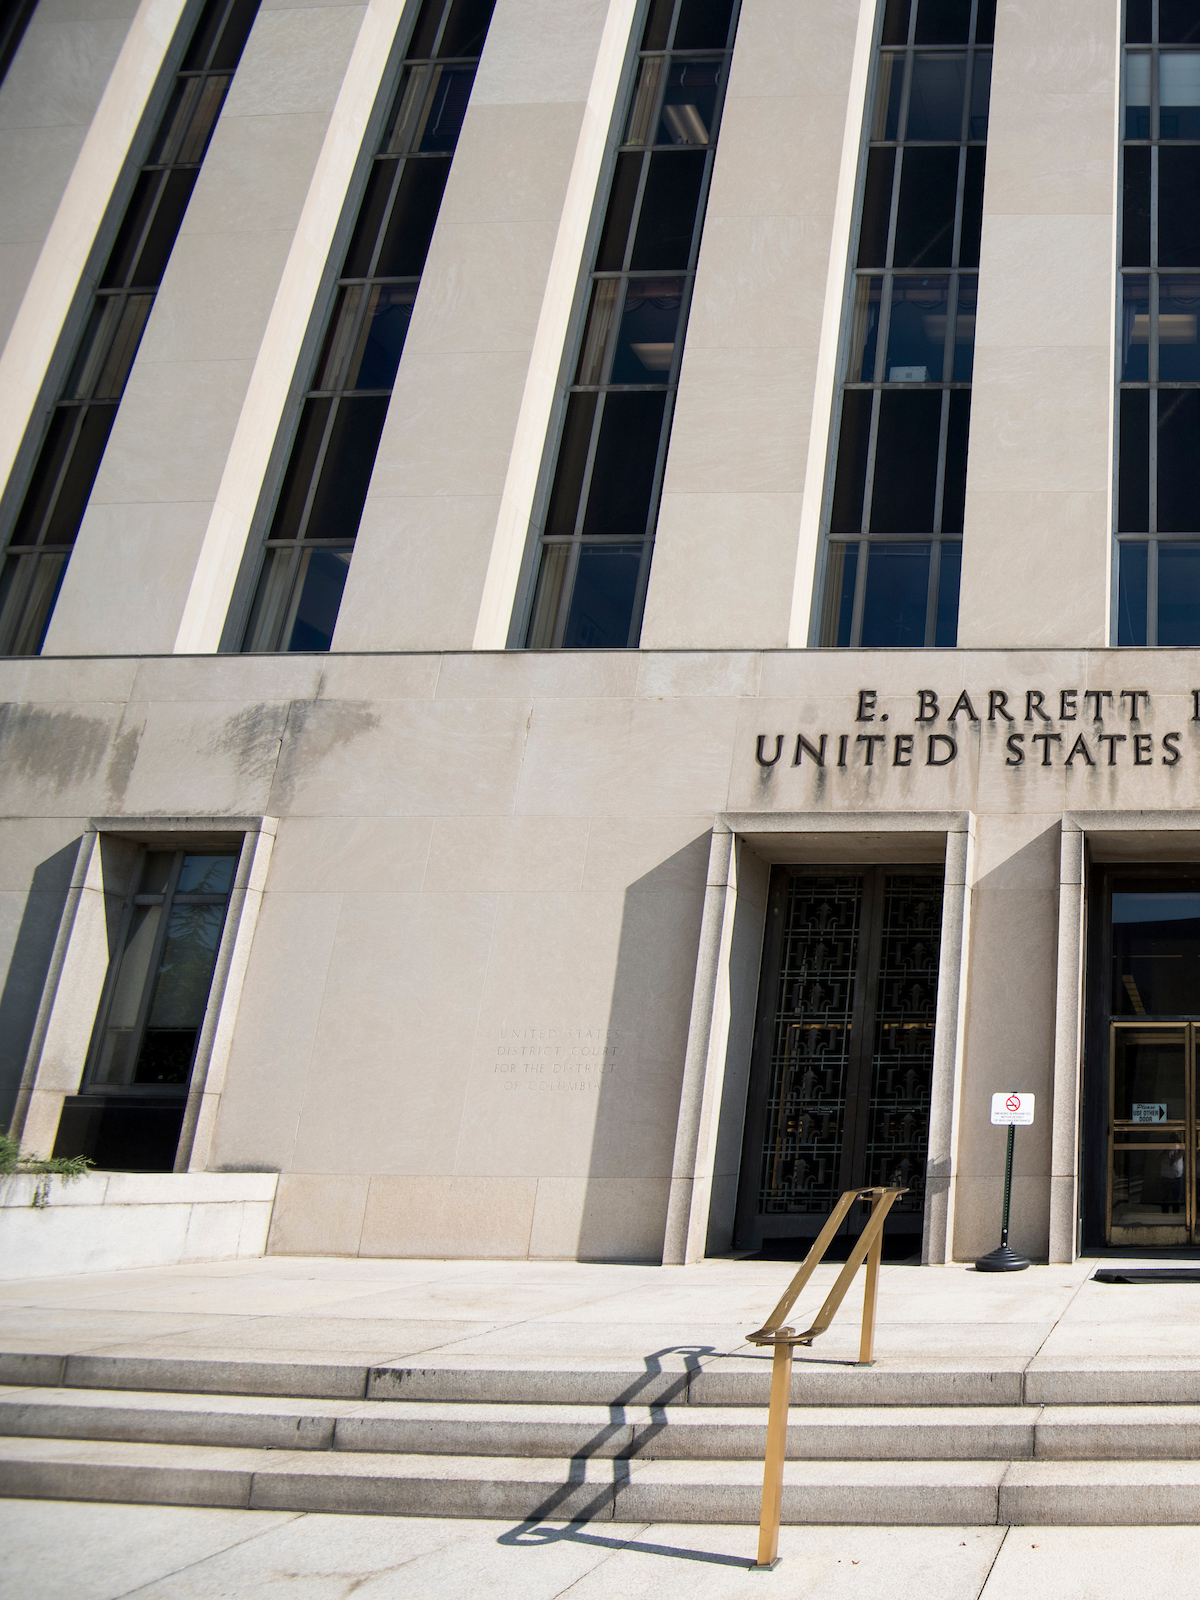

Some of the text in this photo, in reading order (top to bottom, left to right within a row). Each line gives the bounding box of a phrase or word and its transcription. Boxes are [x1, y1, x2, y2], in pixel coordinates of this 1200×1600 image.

[855, 690, 889, 722] E.
[914, 689, 1150, 722] BARRETT
[754, 734, 958, 768] UNITED
[1005, 732, 1181, 767] STATES
[500, 1029, 620, 1039] UNITED STATES
[497, 1046, 618, 1056] DISTRICT COURT
[494, 1064, 616, 1074] FOR THE DISTRICT
[504, 1081, 602, 1091] OF COLUMBIA
